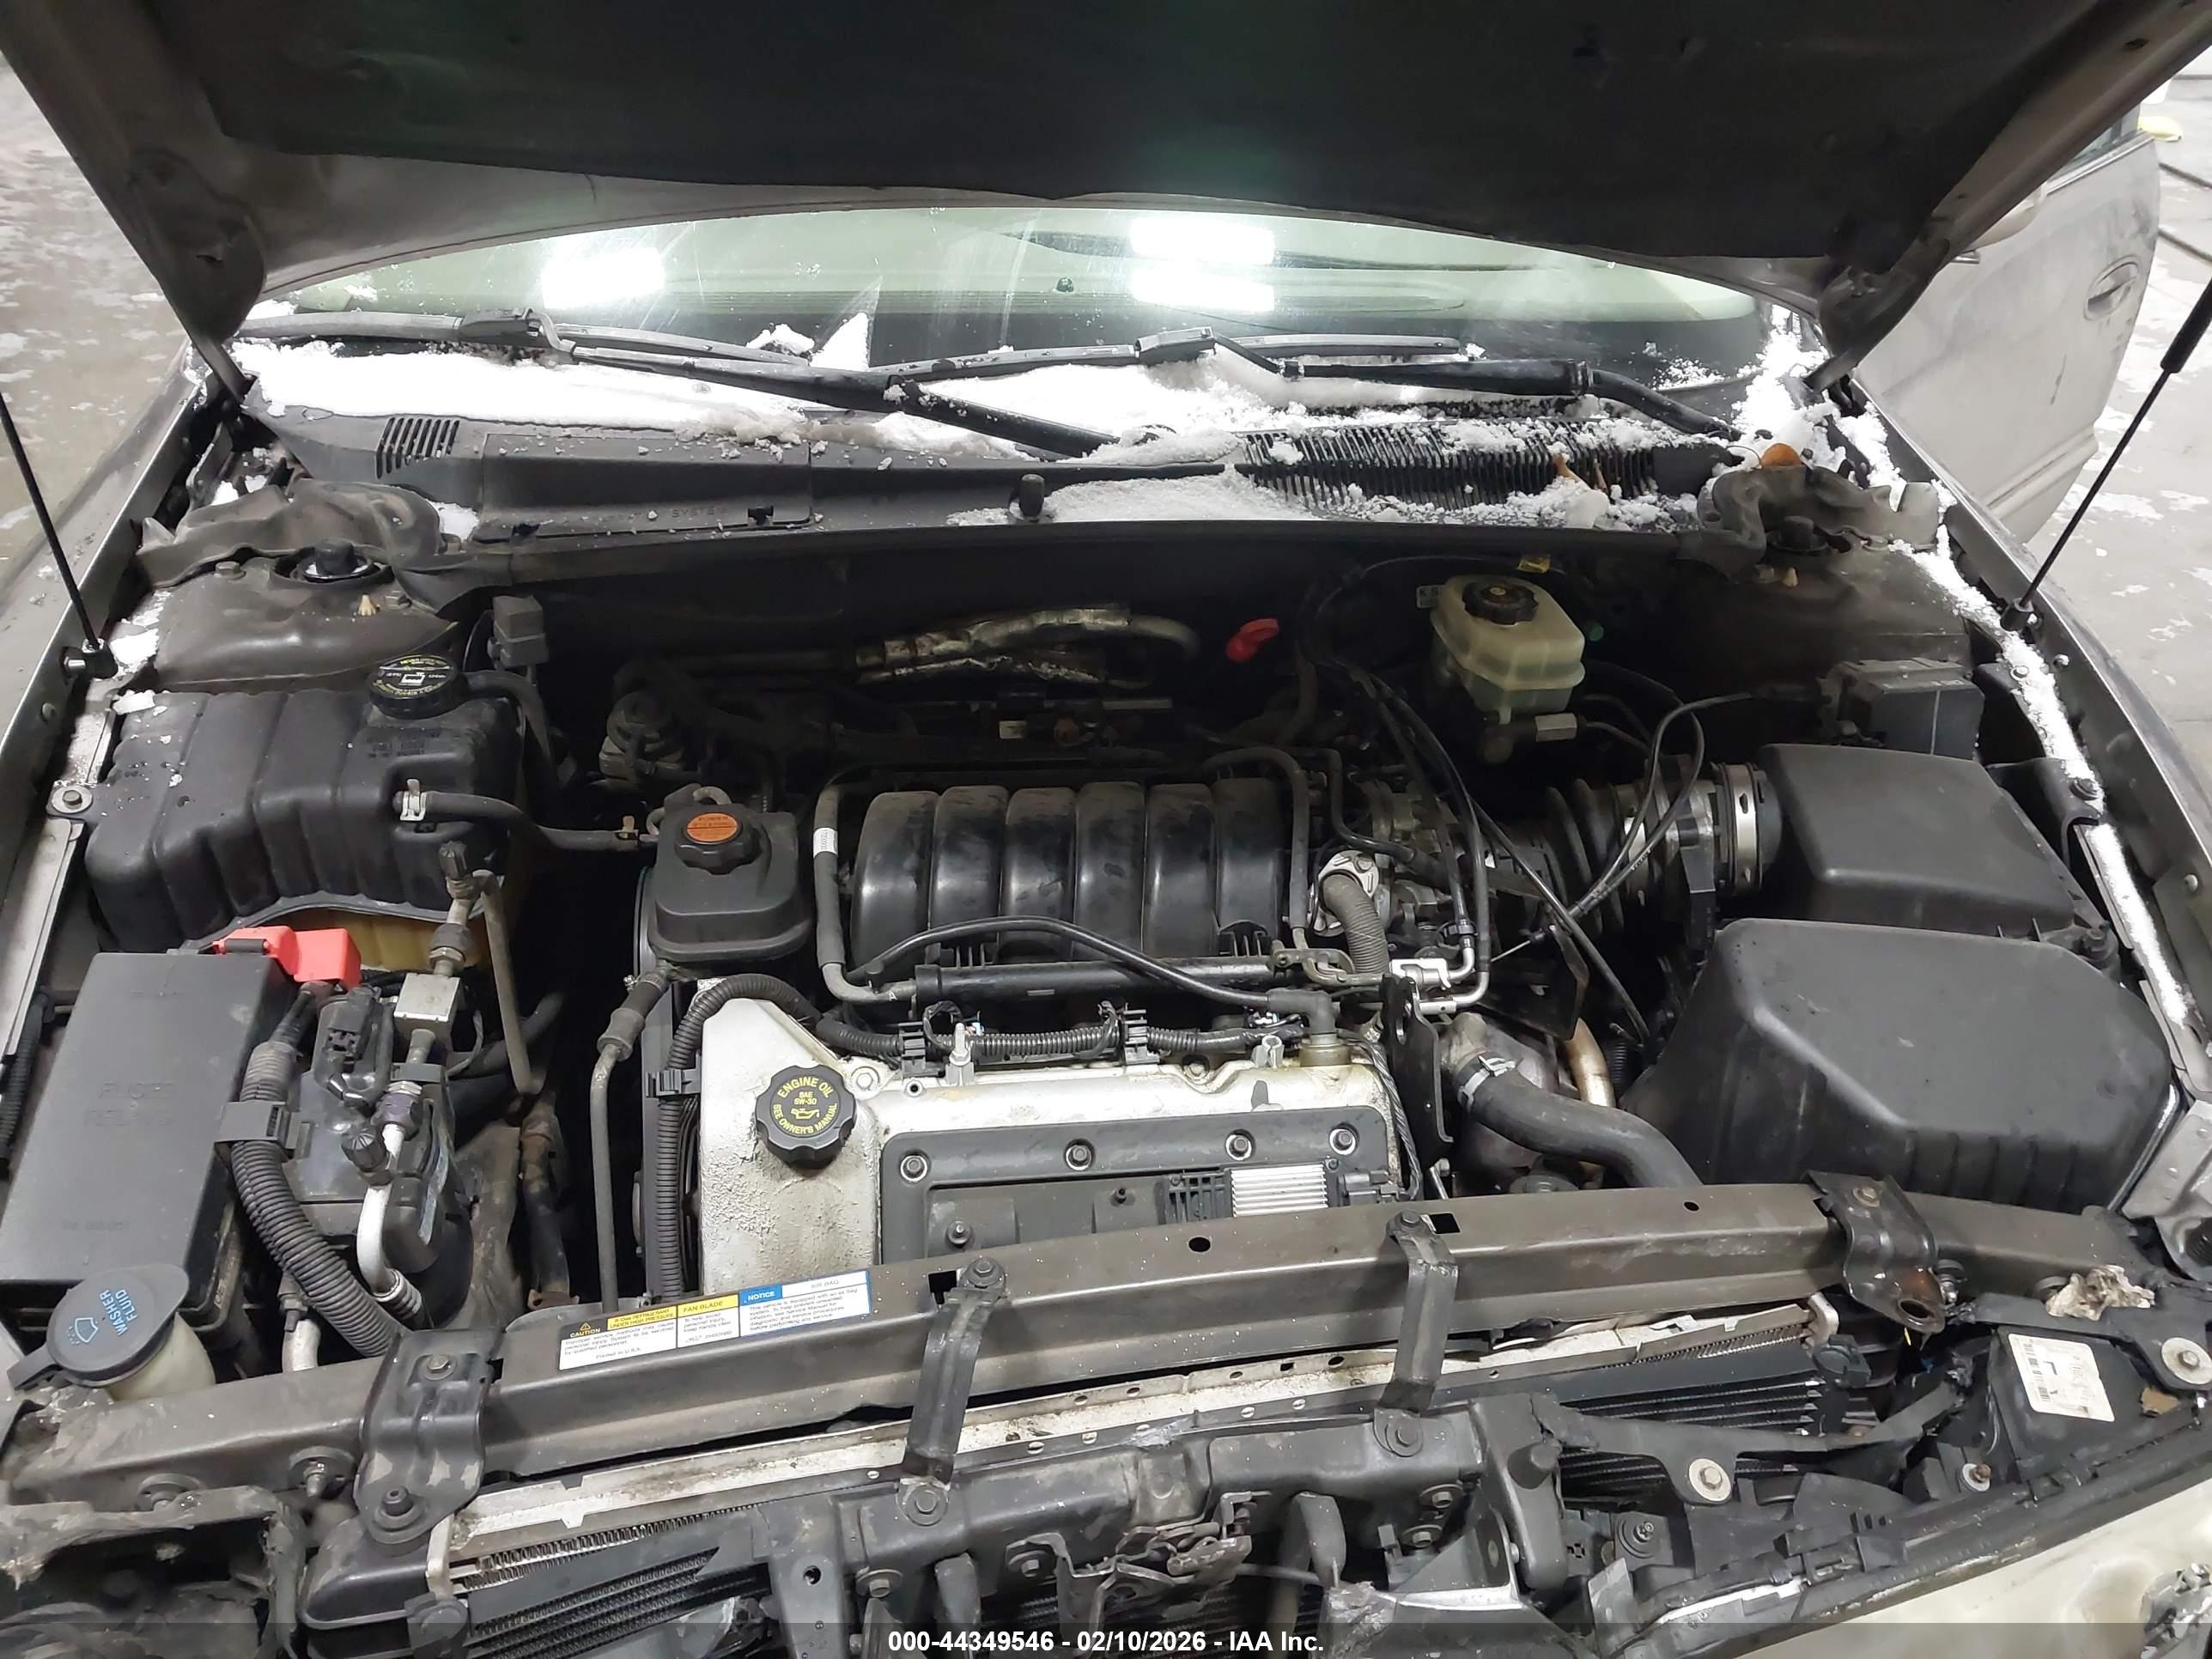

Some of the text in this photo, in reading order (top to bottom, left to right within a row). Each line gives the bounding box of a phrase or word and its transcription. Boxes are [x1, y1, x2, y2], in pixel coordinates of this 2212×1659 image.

[777, 1076, 834, 1098] ENGINE OIL
[774, 1103, 838, 1134] SEE OWNER'S MANUAL
[115, 1289, 137, 1322] FLUID
[699, 1300, 723, 1310] BLADE
[747, 1291, 775, 1301] NOTICE
[99, 1290, 129, 1336] WASHER
[570, 1328, 600, 1338] CAUTION
